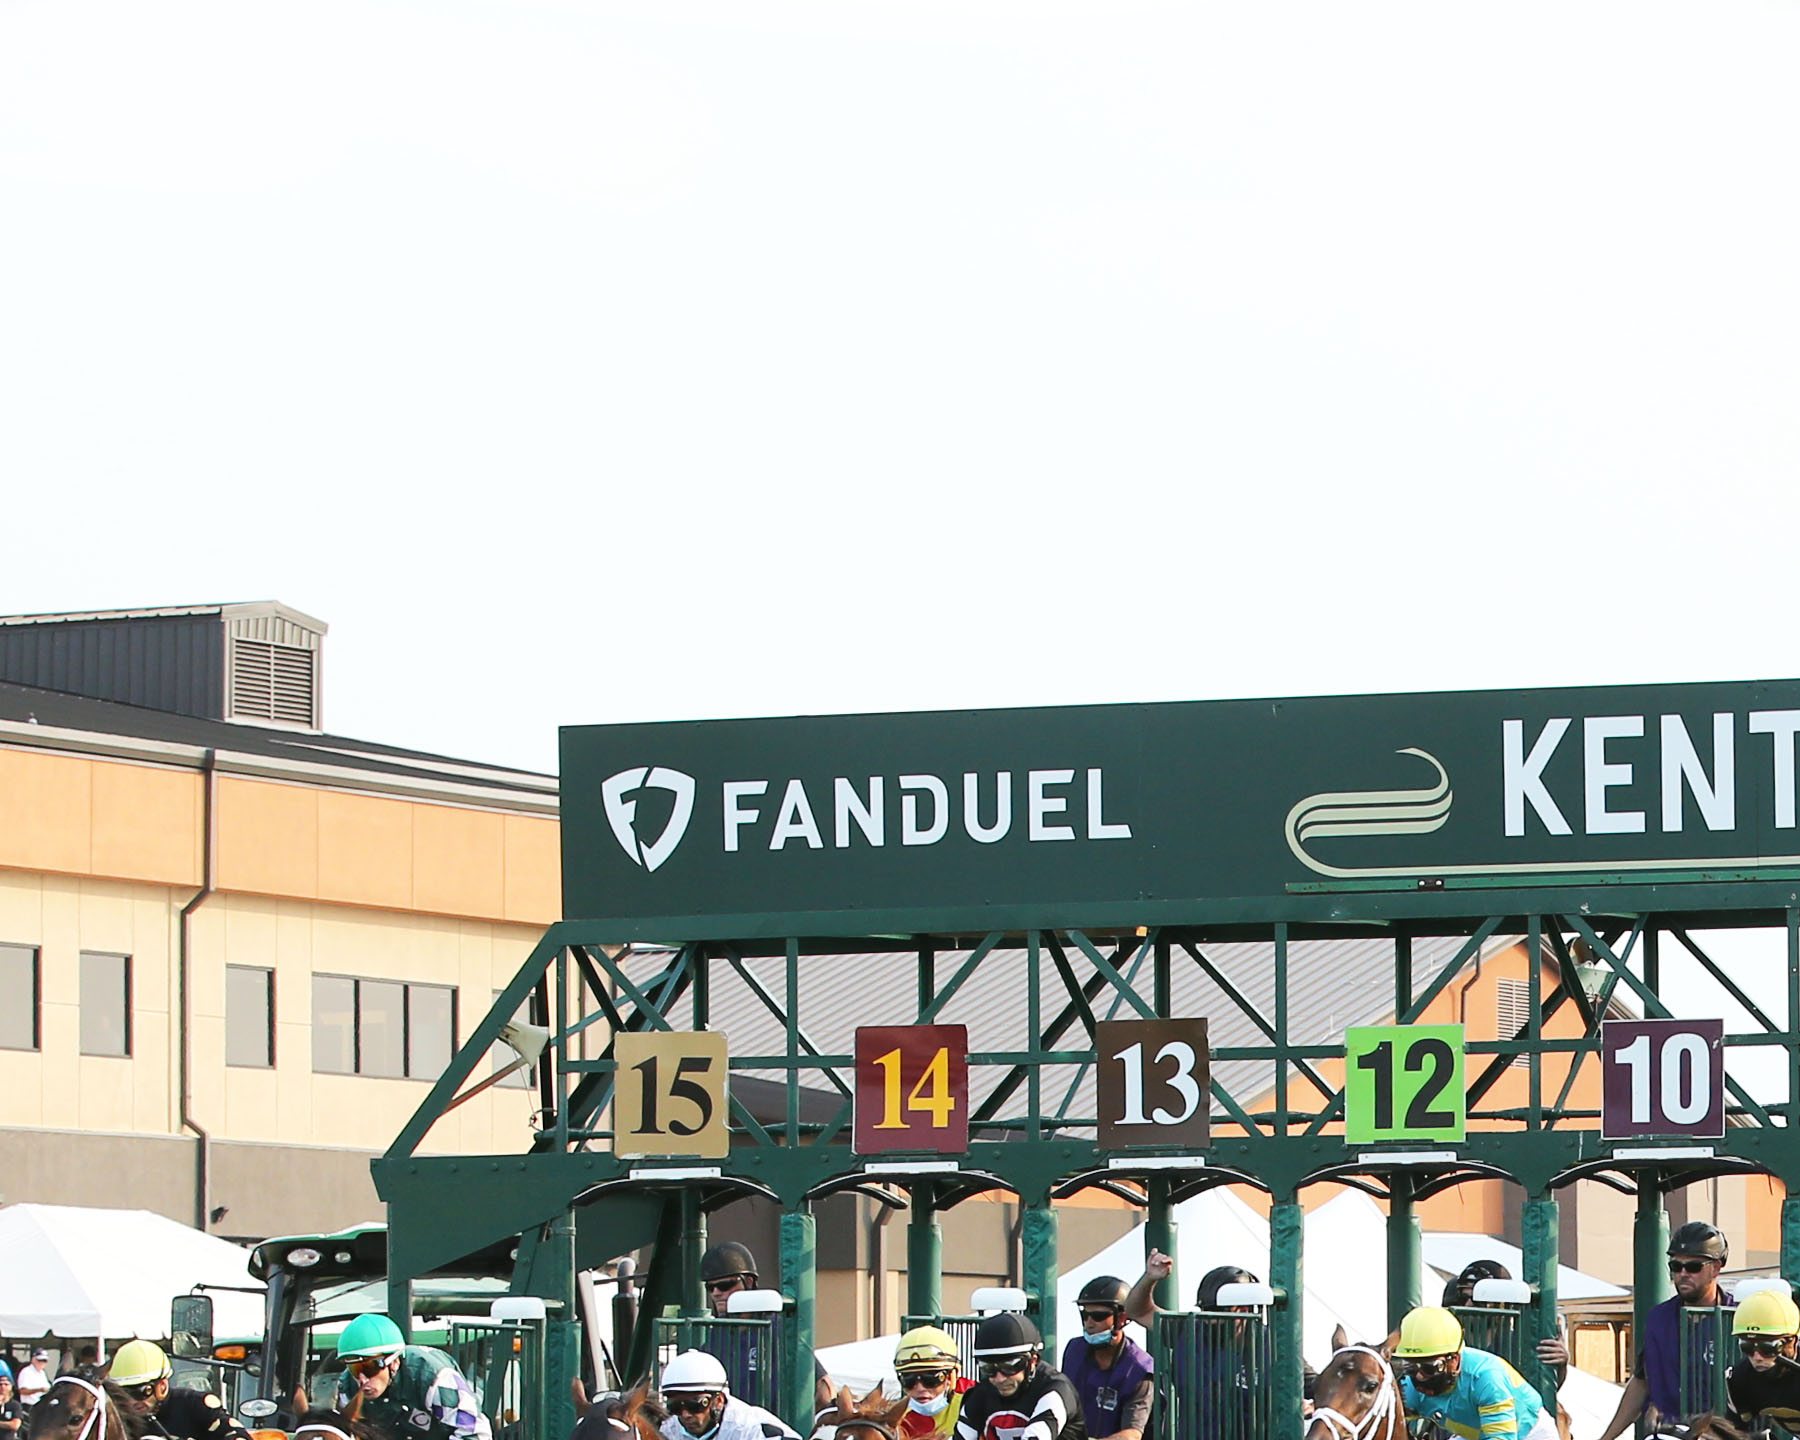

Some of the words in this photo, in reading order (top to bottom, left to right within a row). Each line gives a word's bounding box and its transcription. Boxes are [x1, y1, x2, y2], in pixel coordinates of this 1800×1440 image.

[723, 768, 1132, 852] FANDUEL
[630, 1055, 714, 1136] 15
[872, 1047, 956, 1130] 14
[1112, 1041, 1201, 1126] 13
[1356, 1038, 1457, 1130] 12
[1613, 1033, 1712, 1125] 10
